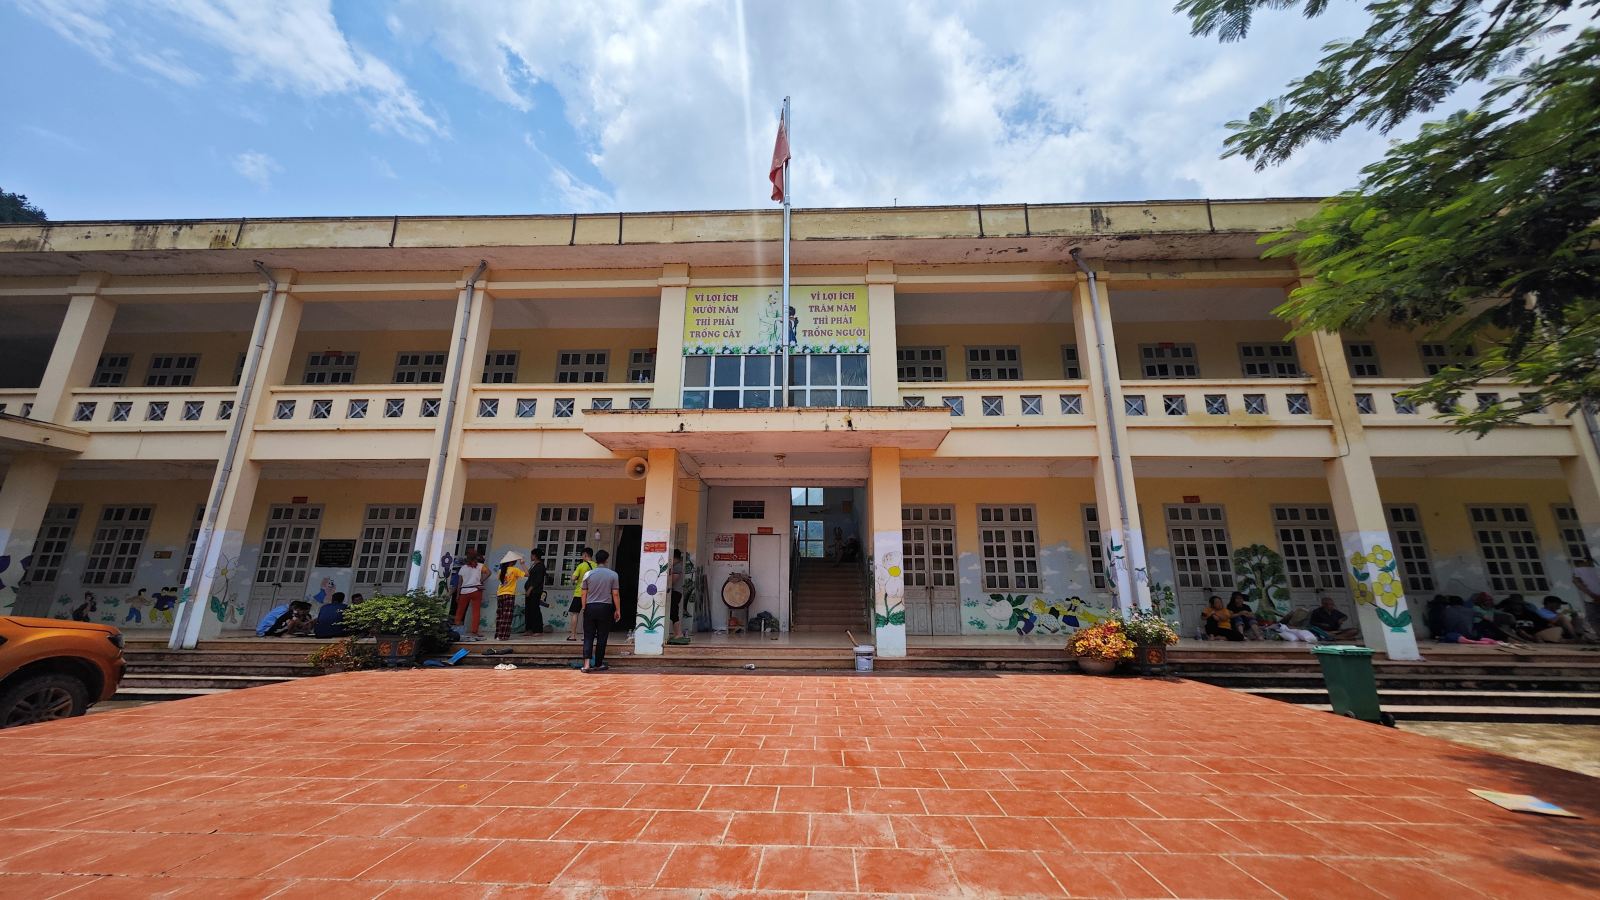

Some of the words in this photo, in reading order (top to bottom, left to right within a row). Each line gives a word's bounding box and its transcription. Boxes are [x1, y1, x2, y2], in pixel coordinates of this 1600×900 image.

[707, 294, 720, 303] LỢI
[723, 292, 738, 301] ÍCH
[823, 293, 837, 301] LỢI
[840, 291, 854, 299] ÍCH
[693, 304, 716, 313] MƯỜI
[696, 316, 710, 325] THÌ
[713, 316, 734, 325] PHẢI
[813, 315, 828, 324] THÌ
[831, 314, 852, 324] PHẢI
[690, 328, 720, 338] TRỒNG
[723, 329, 741, 338] CÂY
[802, 326, 833, 336] TRỒNG
[836, 328, 865, 336] NGƯỜI
